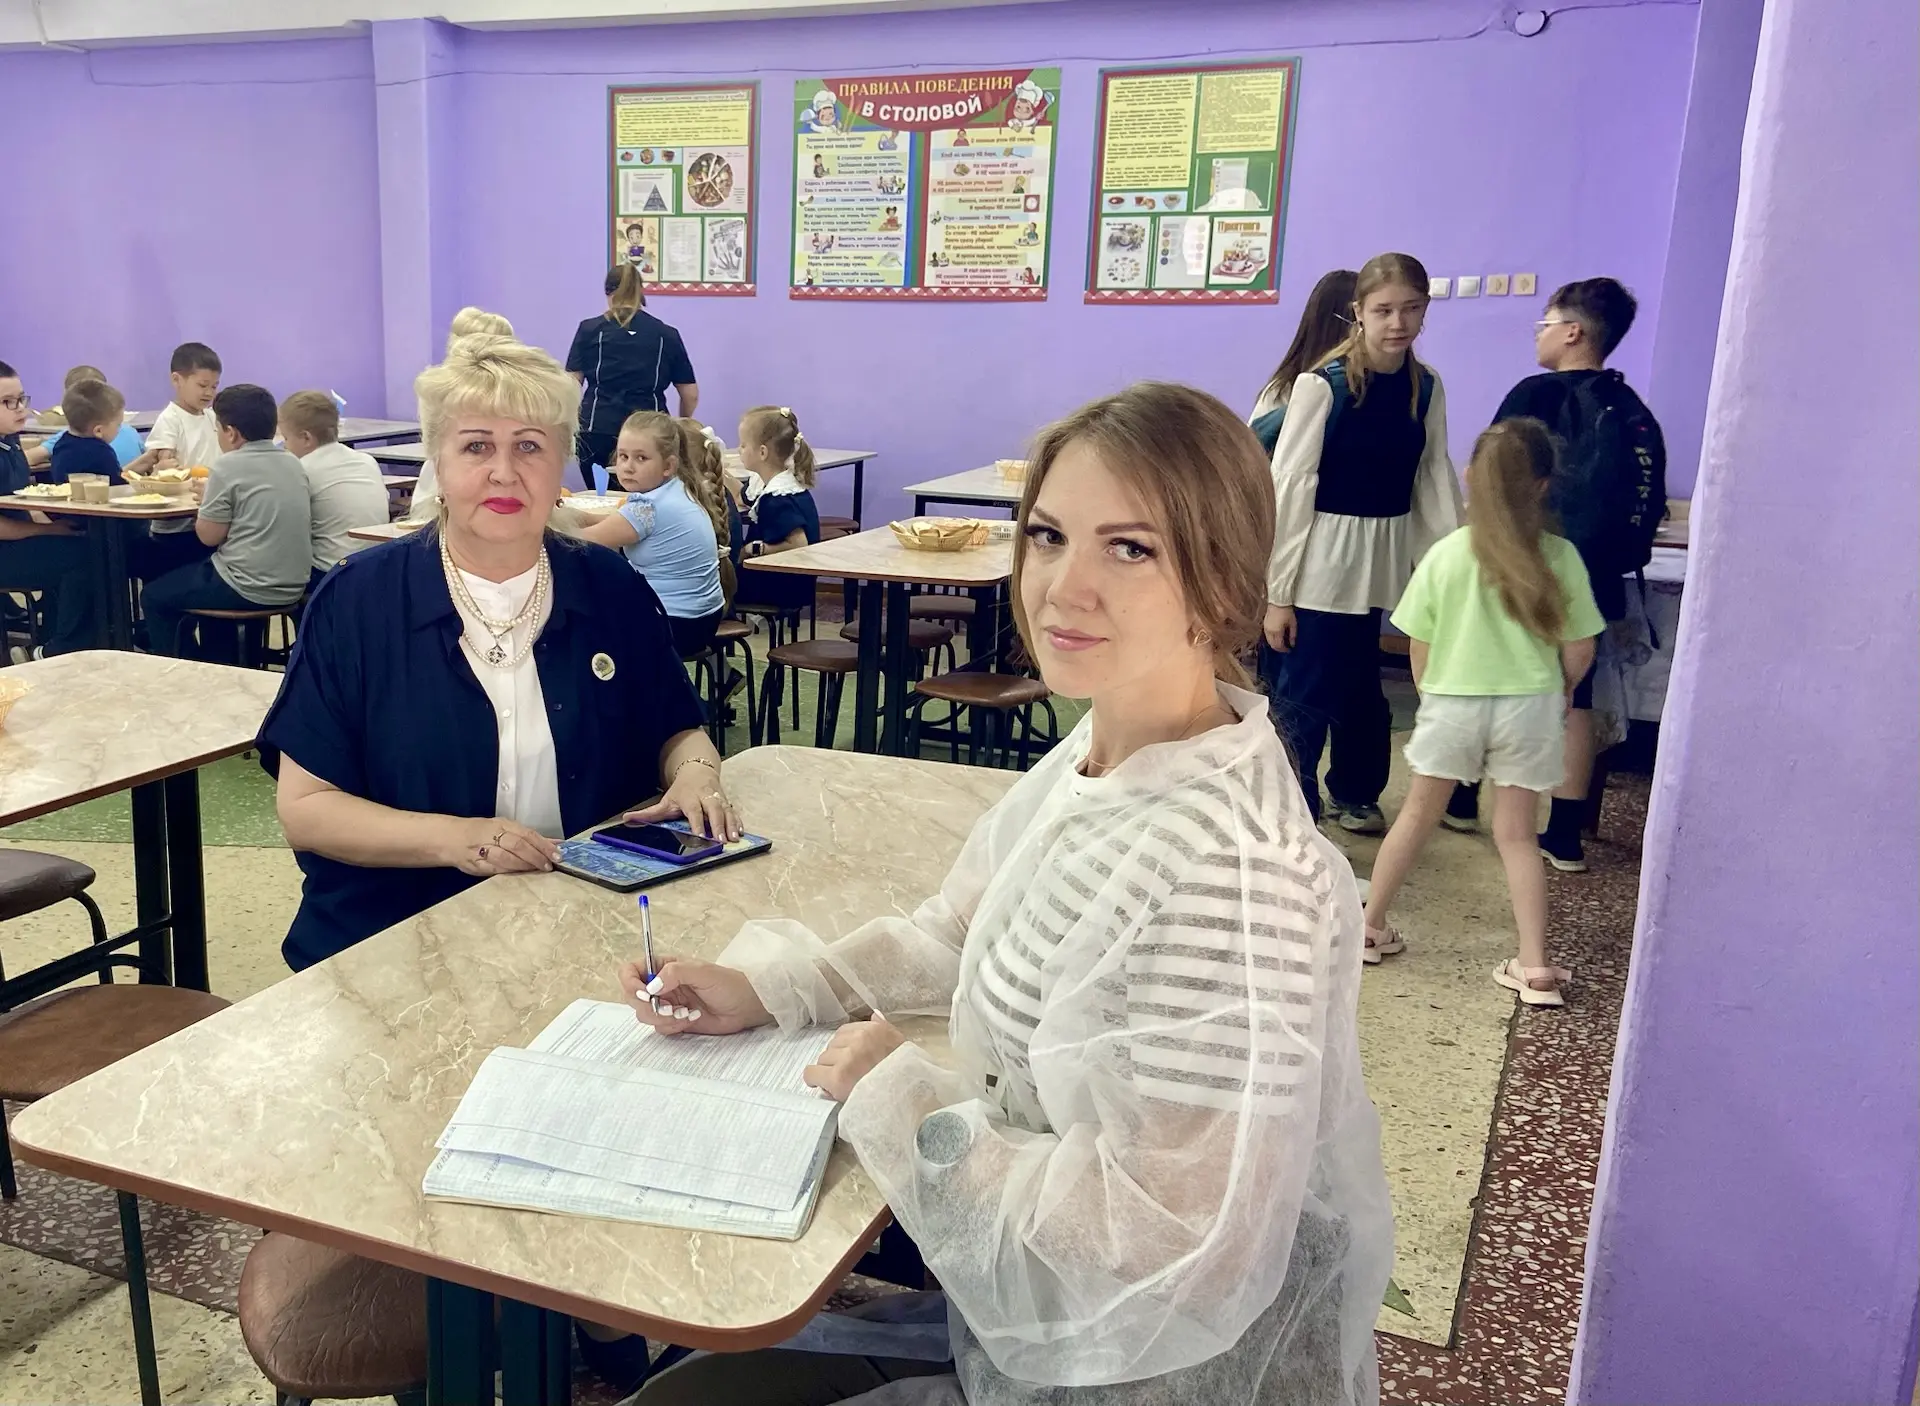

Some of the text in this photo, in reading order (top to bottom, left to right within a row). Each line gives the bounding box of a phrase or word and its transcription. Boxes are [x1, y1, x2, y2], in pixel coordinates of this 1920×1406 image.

[839, 76, 1013, 96] ПРАВИЛА ПОВЕДЕНИЯ
[862, 93, 982, 122] В СТОЛОВОЙ
